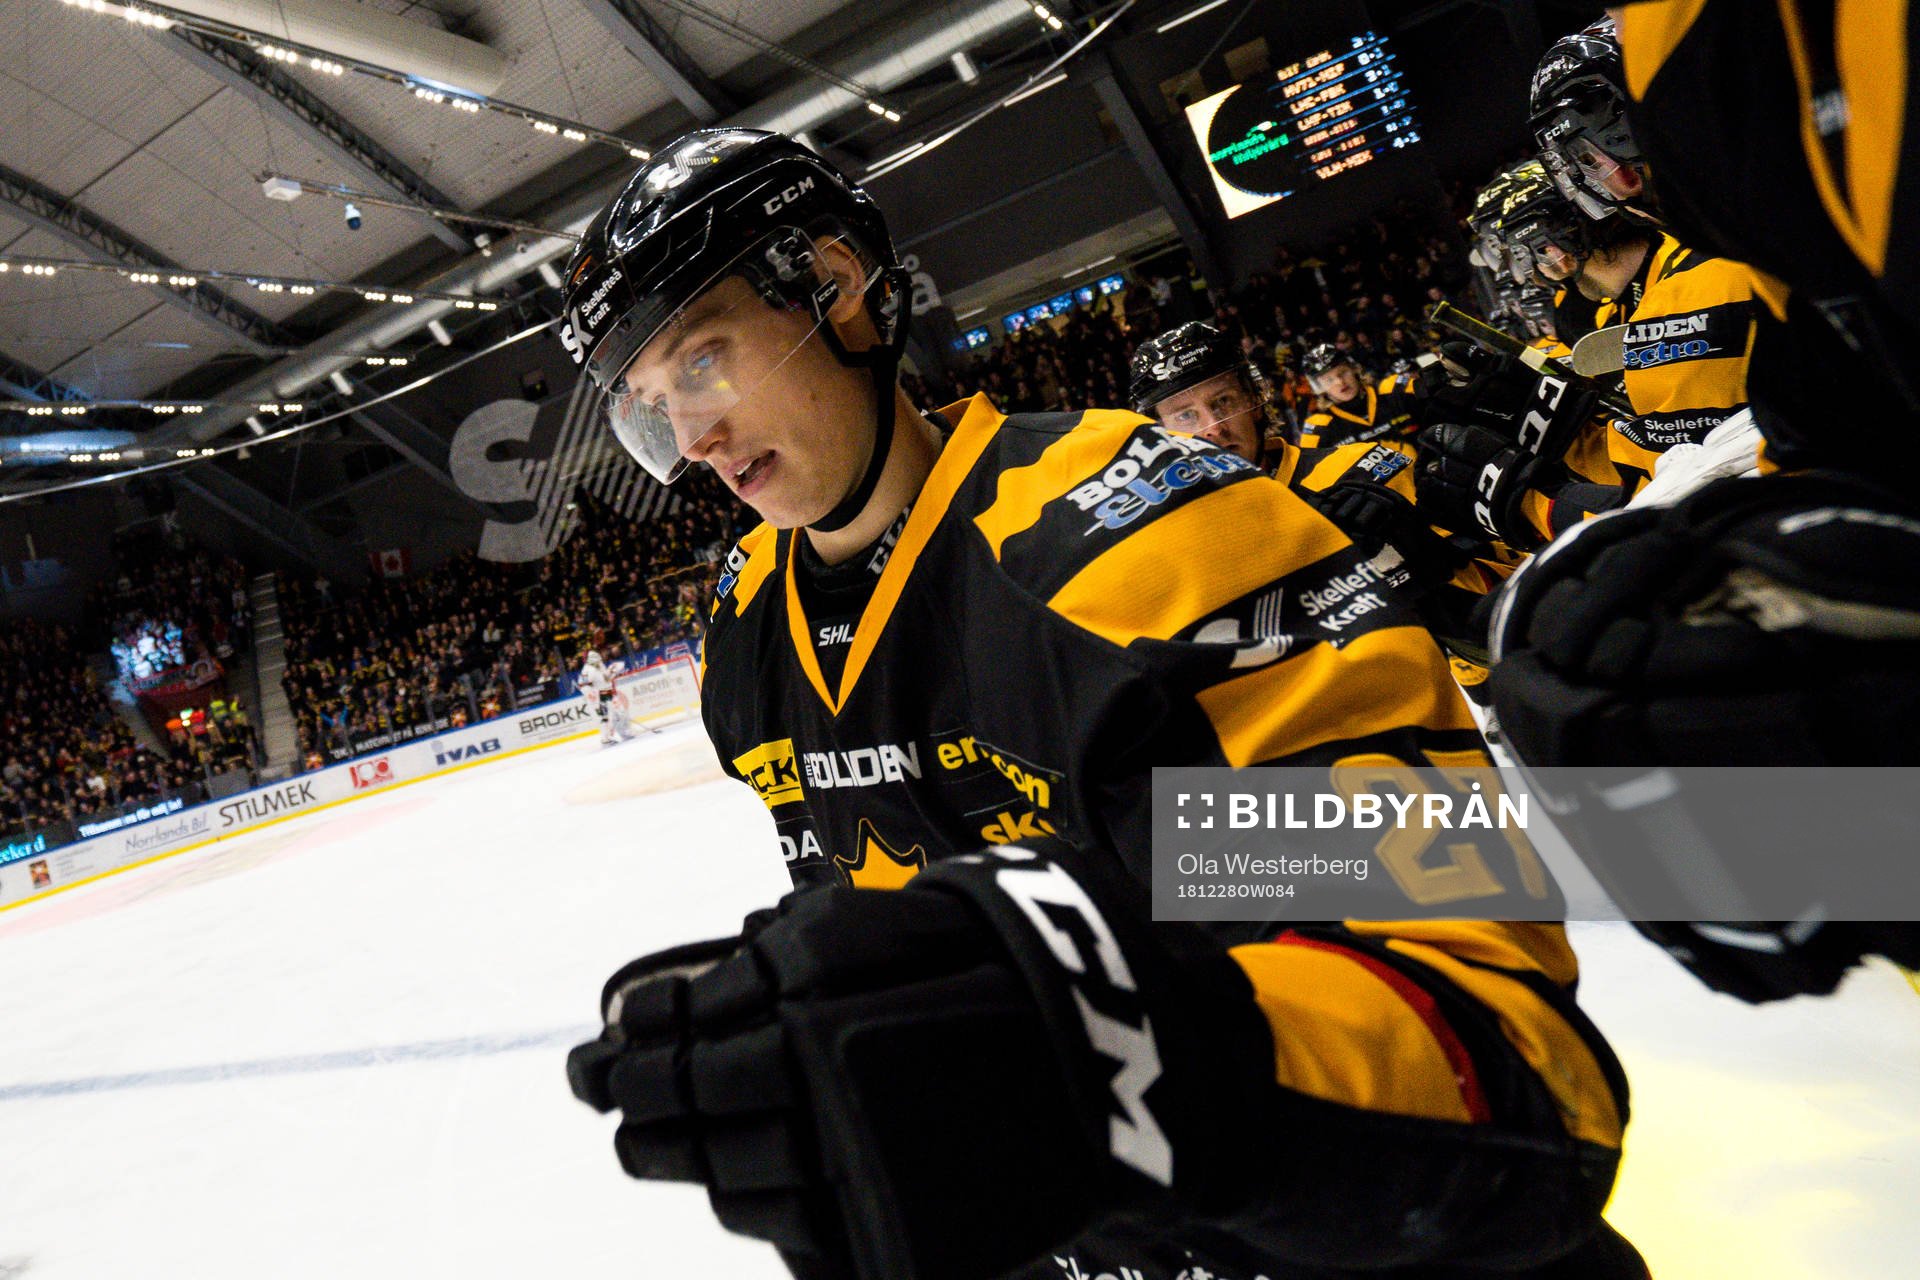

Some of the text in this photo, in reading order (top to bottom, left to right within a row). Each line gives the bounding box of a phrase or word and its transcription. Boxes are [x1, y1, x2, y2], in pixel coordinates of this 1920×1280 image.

[1544, 119, 1570, 142] CCM
[764, 175, 815, 217] CCM
[1515, 223, 1537, 239] CCM
[581, 268, 622, 316] Skellefteå
[818, 284, 837, 302] CCM
[587, 302, 611, 329] Kraft
[1647, 431, 1691, 444] Kraft
[1319, 592, 1387, 631] Kraft
[818, 624, 855, 647] SHL
[520, 703, 591, 736] BROKK
[436, 738, 502, 767] IVAB
